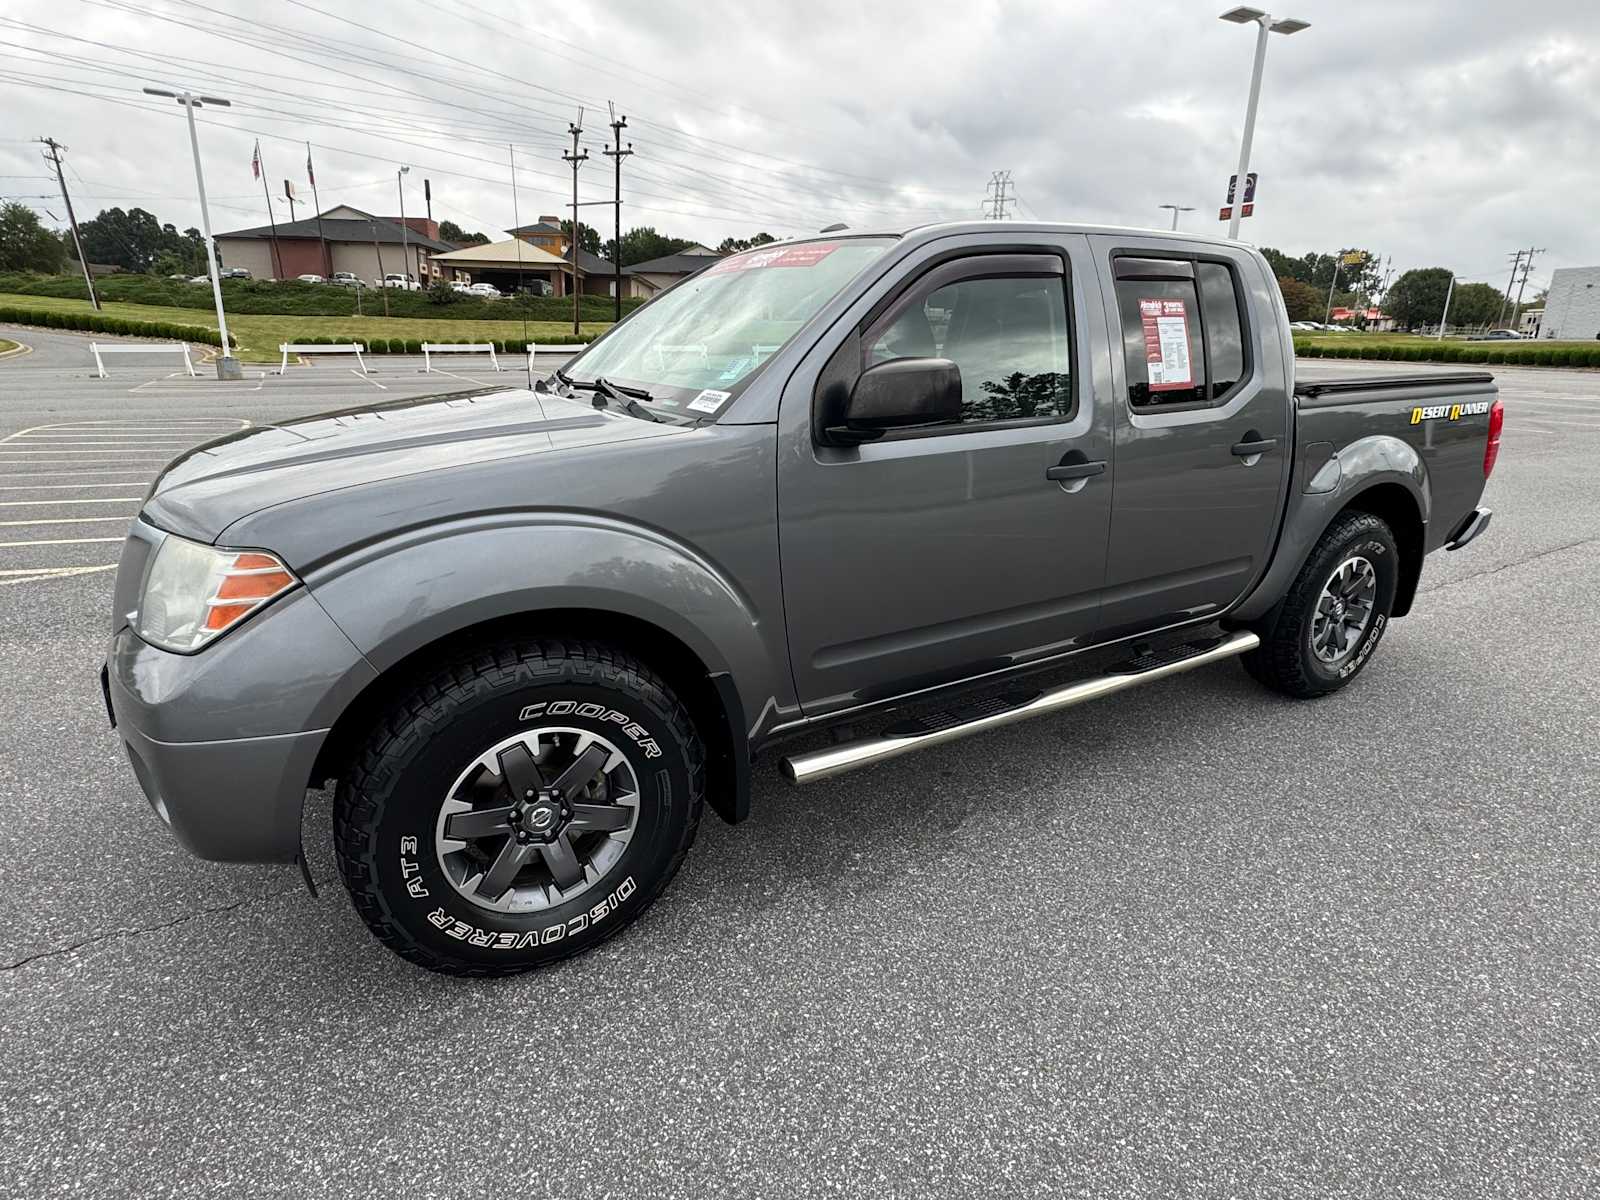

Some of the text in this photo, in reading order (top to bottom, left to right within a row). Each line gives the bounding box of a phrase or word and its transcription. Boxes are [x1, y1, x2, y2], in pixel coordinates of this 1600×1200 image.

[1410, 402, 1488, 424] DESERT RUNNER
[1338, 613, 1386, 678] COOPER
[518, 700, 662, 759] COOPER
[400, 835, 637, 949] DISCOVERER AT3
